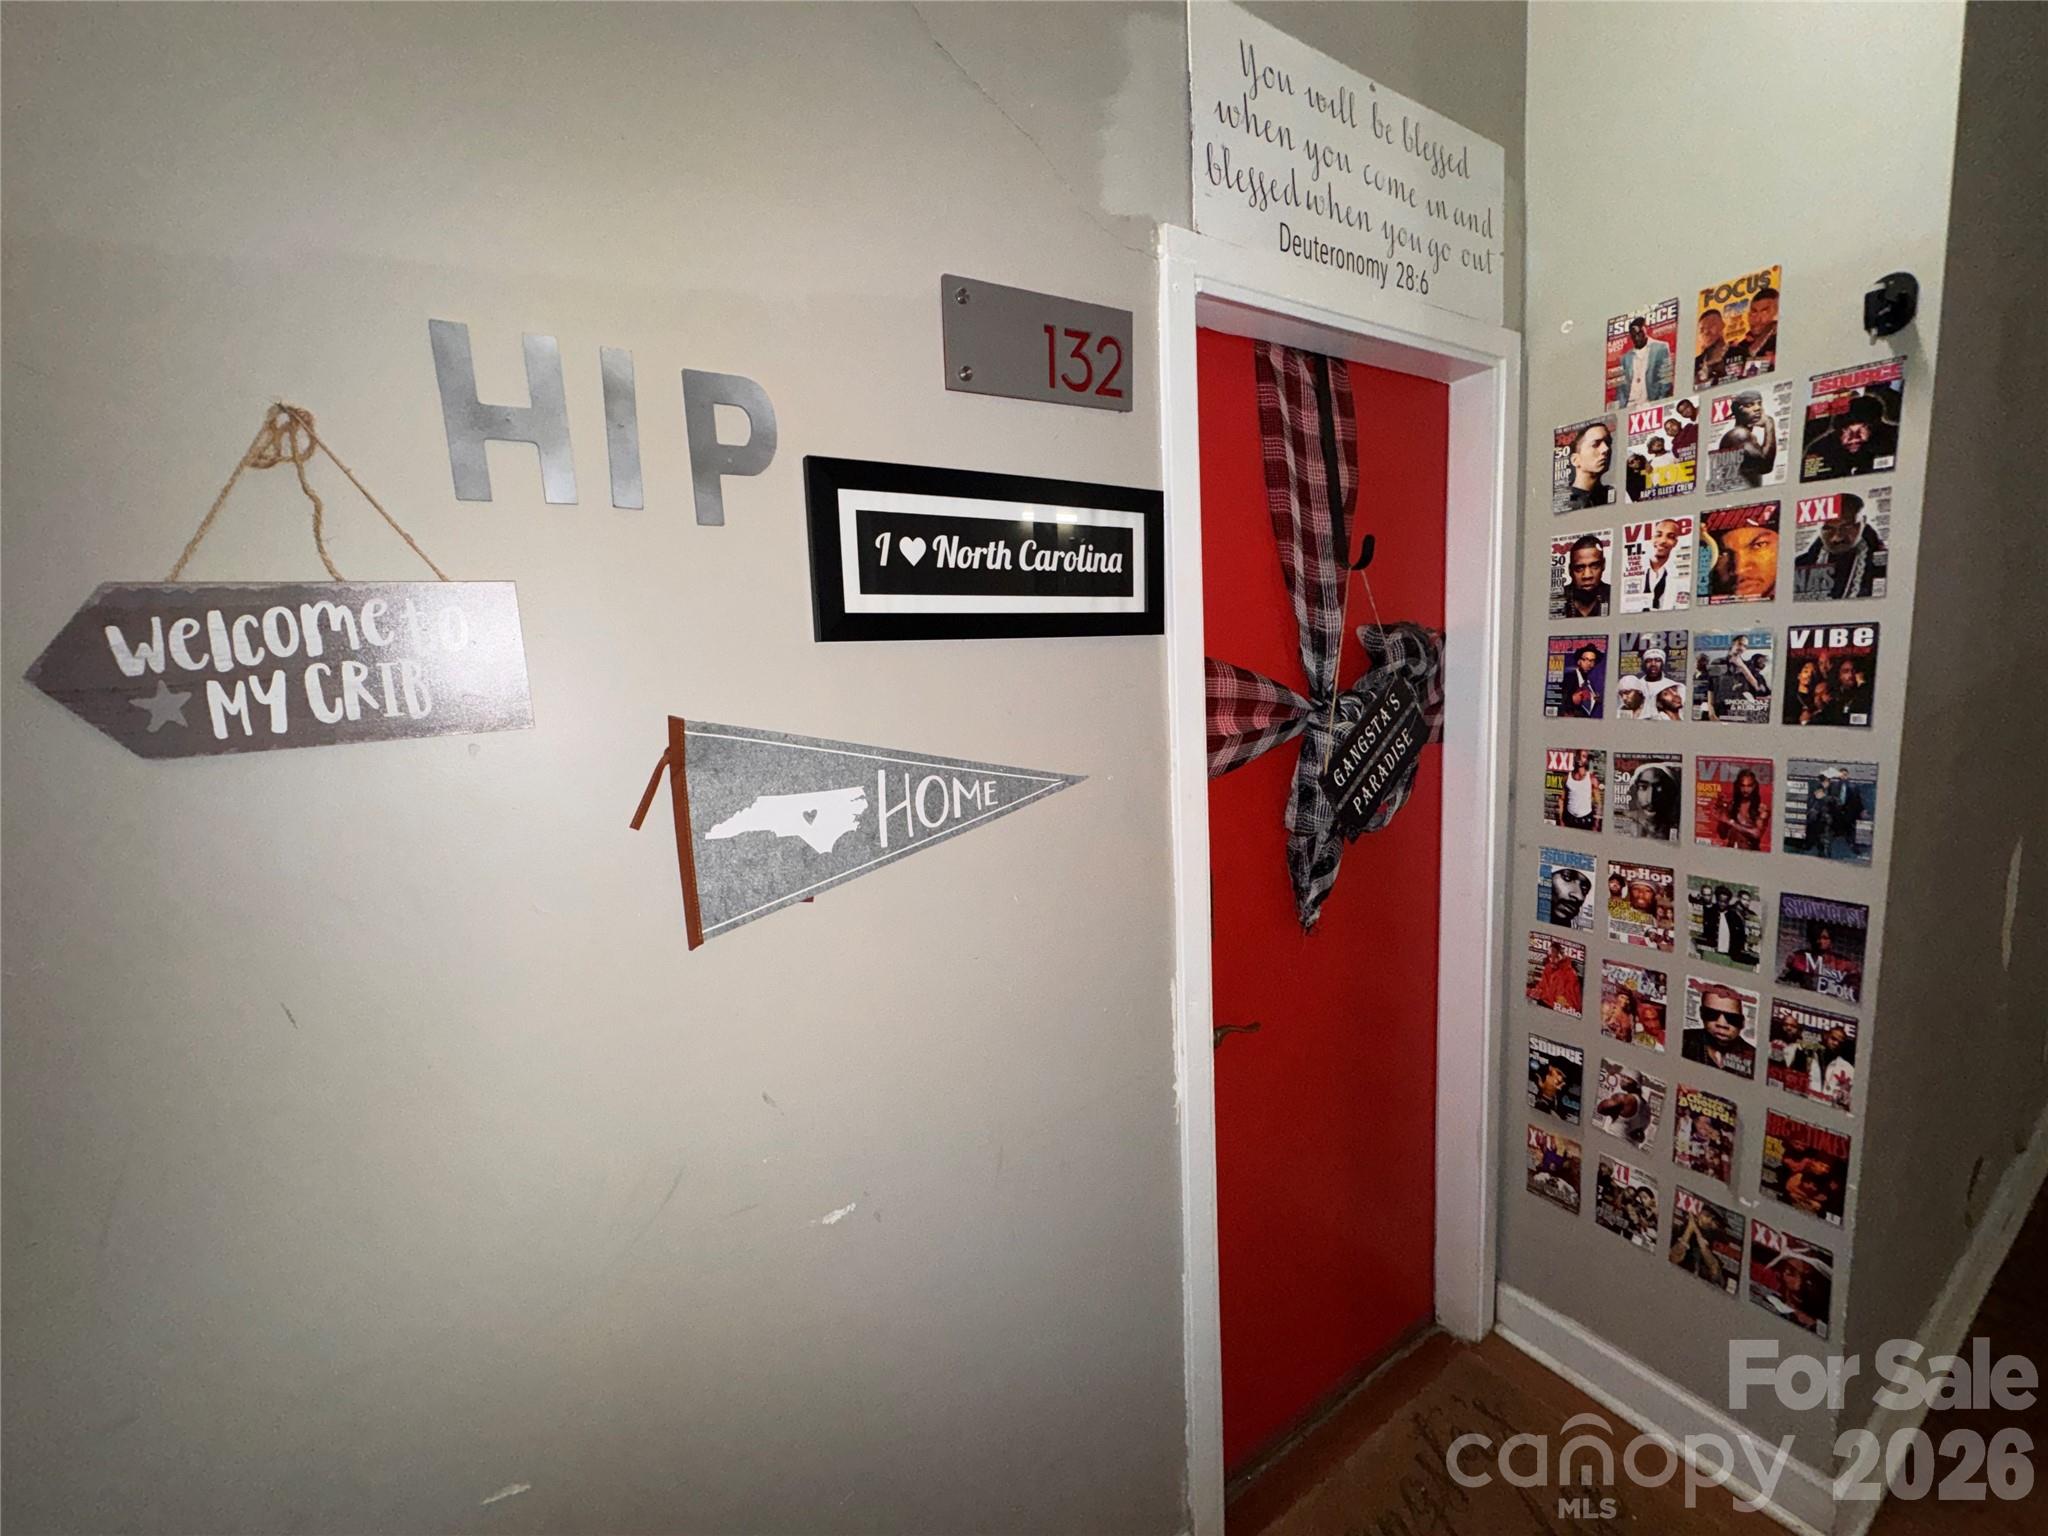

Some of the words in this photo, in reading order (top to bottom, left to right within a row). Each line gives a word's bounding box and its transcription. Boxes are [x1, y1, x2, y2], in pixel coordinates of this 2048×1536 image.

[1239, 38, 1294, 100] You
[1304, 86, 1357, 128] will
[1372, 101, 1393, 145] be
[1402, 116, 1470, 179] blessed
[1214, 92, 1295, 151] when
[1303, 139, 1351, 182] you
[1363, 163, 1417, 208] come
[1453, 206, 1493, 239] and
[1205, 142, 1300, 212] blessed
[1305, 182, 1370, 233] when
[1382, 220, 1422, 259] you
[1428, 238, 1452, 274] go
[1461, 250, 1493, 274] out
[1279, 222, 1388, 289] Deuteronomy
[1395, 261, 1430, 295] 28:6
[1043, 324, 1126, 399] 132
[428, 318, 778, 526] HIP
[1628, 409, 1661, 434] XXL
[1554, 445, 1571, 459] 50
[1554, 458, 1569, 471] HIP
[1554, 468, 1572, 481] HOP
[1798, 496, 1838, 523] XXL
[874, 531, 891, 567] I
[932, 534, 1013, 570] North
[1018, 539, 1124, 574] Carolina
[1551, 555, 1566, 567] 50
[1551, 567, 1566, 579] HIP
[1551, 577, 1568, 588] HOP
[205, 669, 288, 740] MY
[305, 660, 433, 725] CRIB
[1332, 692, 1401, 788] GANGSTA'S
[1351, 727, 1414, 815] PARADISE
[1614, 771, 1630, 783] 50
[877, 769, 999, 848] HOME
[1614, 794, 1632, 805] HOP
[1529, 1037, 1584, 1066] SOURCE
